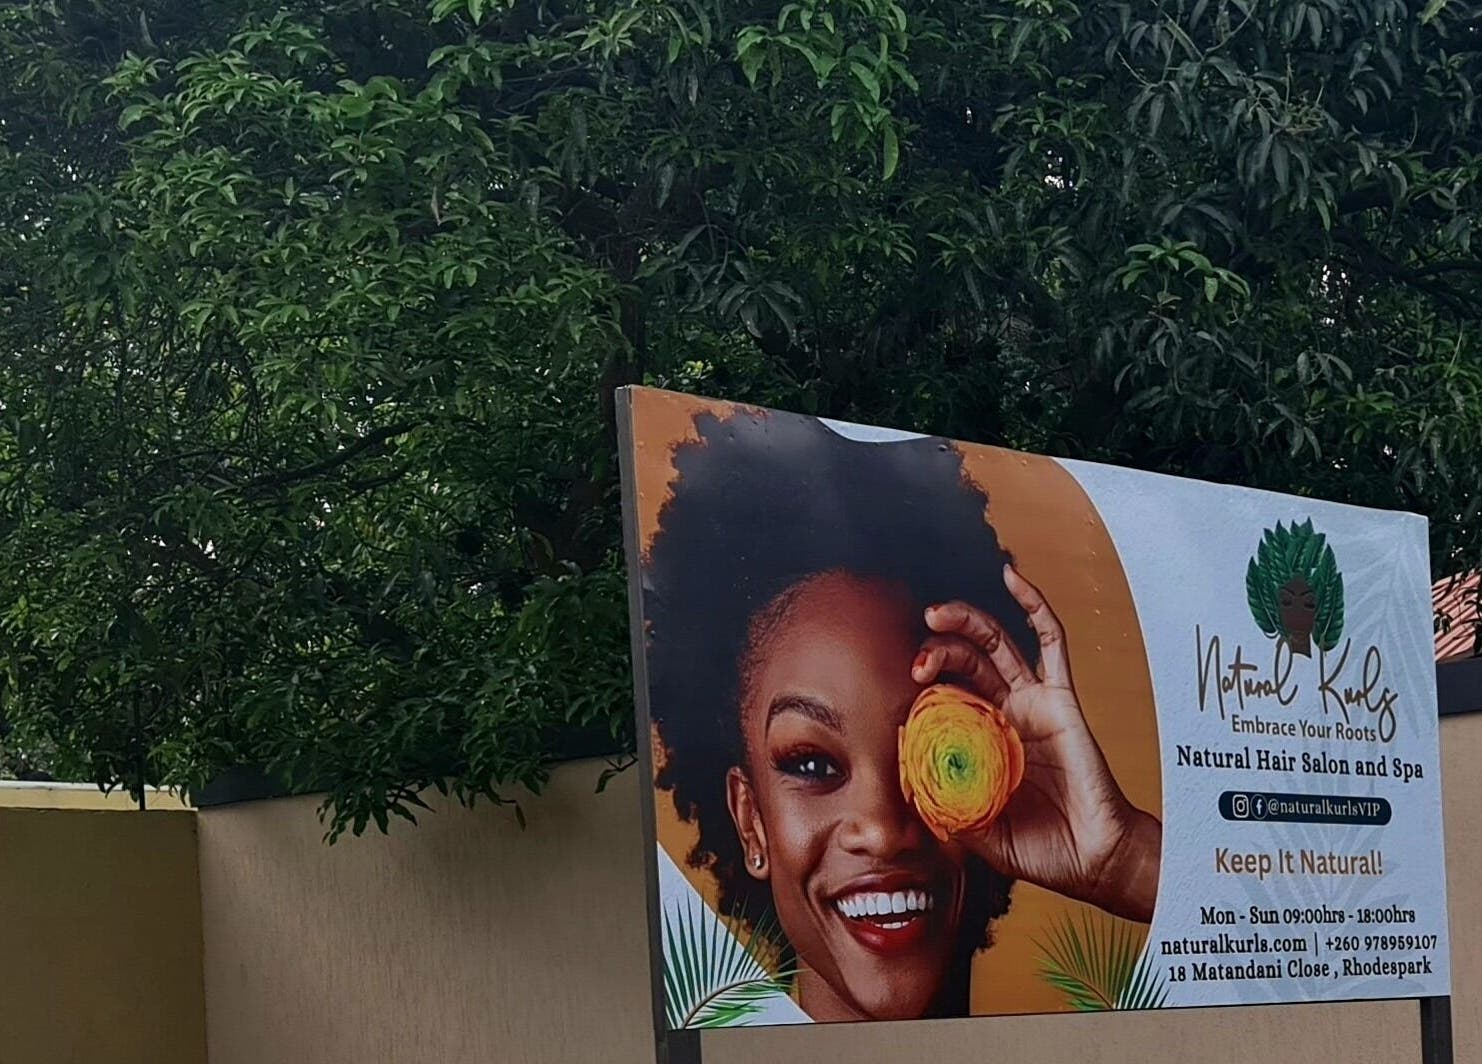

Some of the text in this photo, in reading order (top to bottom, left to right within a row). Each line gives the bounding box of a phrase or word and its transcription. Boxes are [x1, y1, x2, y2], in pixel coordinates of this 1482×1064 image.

[1196, 624, 1398, 742] Natural Kurls
[1232, 714, 1376, 741] Embrace Your Roots
[1176, 745, 1423, 783] Natural Hair Salon and Spa
[1267, 799, 1381, 817] @naturalkurlsVIP
[1215, 848, 1383, 880] Keep It Natural!
[1200, 906, 1235, 925] Mon
[1250, 906, 1280, 924] Sun
[1283, 904, 1345, 924] 09:00hrs
[1357, 904, 1416, 923] 18:00hrs
[1161, 933, 1307, 955] naturalkurls.com
[1325, 935, 1359, 951] +260
[1365, 935, 1438, 951] 978959107
[1168, 966, 1186, 982] 18
[1192, 959, 1282, 981] Matandani
[1287, 958, 1330, 978] Close
[1343, 955, 1432, 979] Rhodespark
